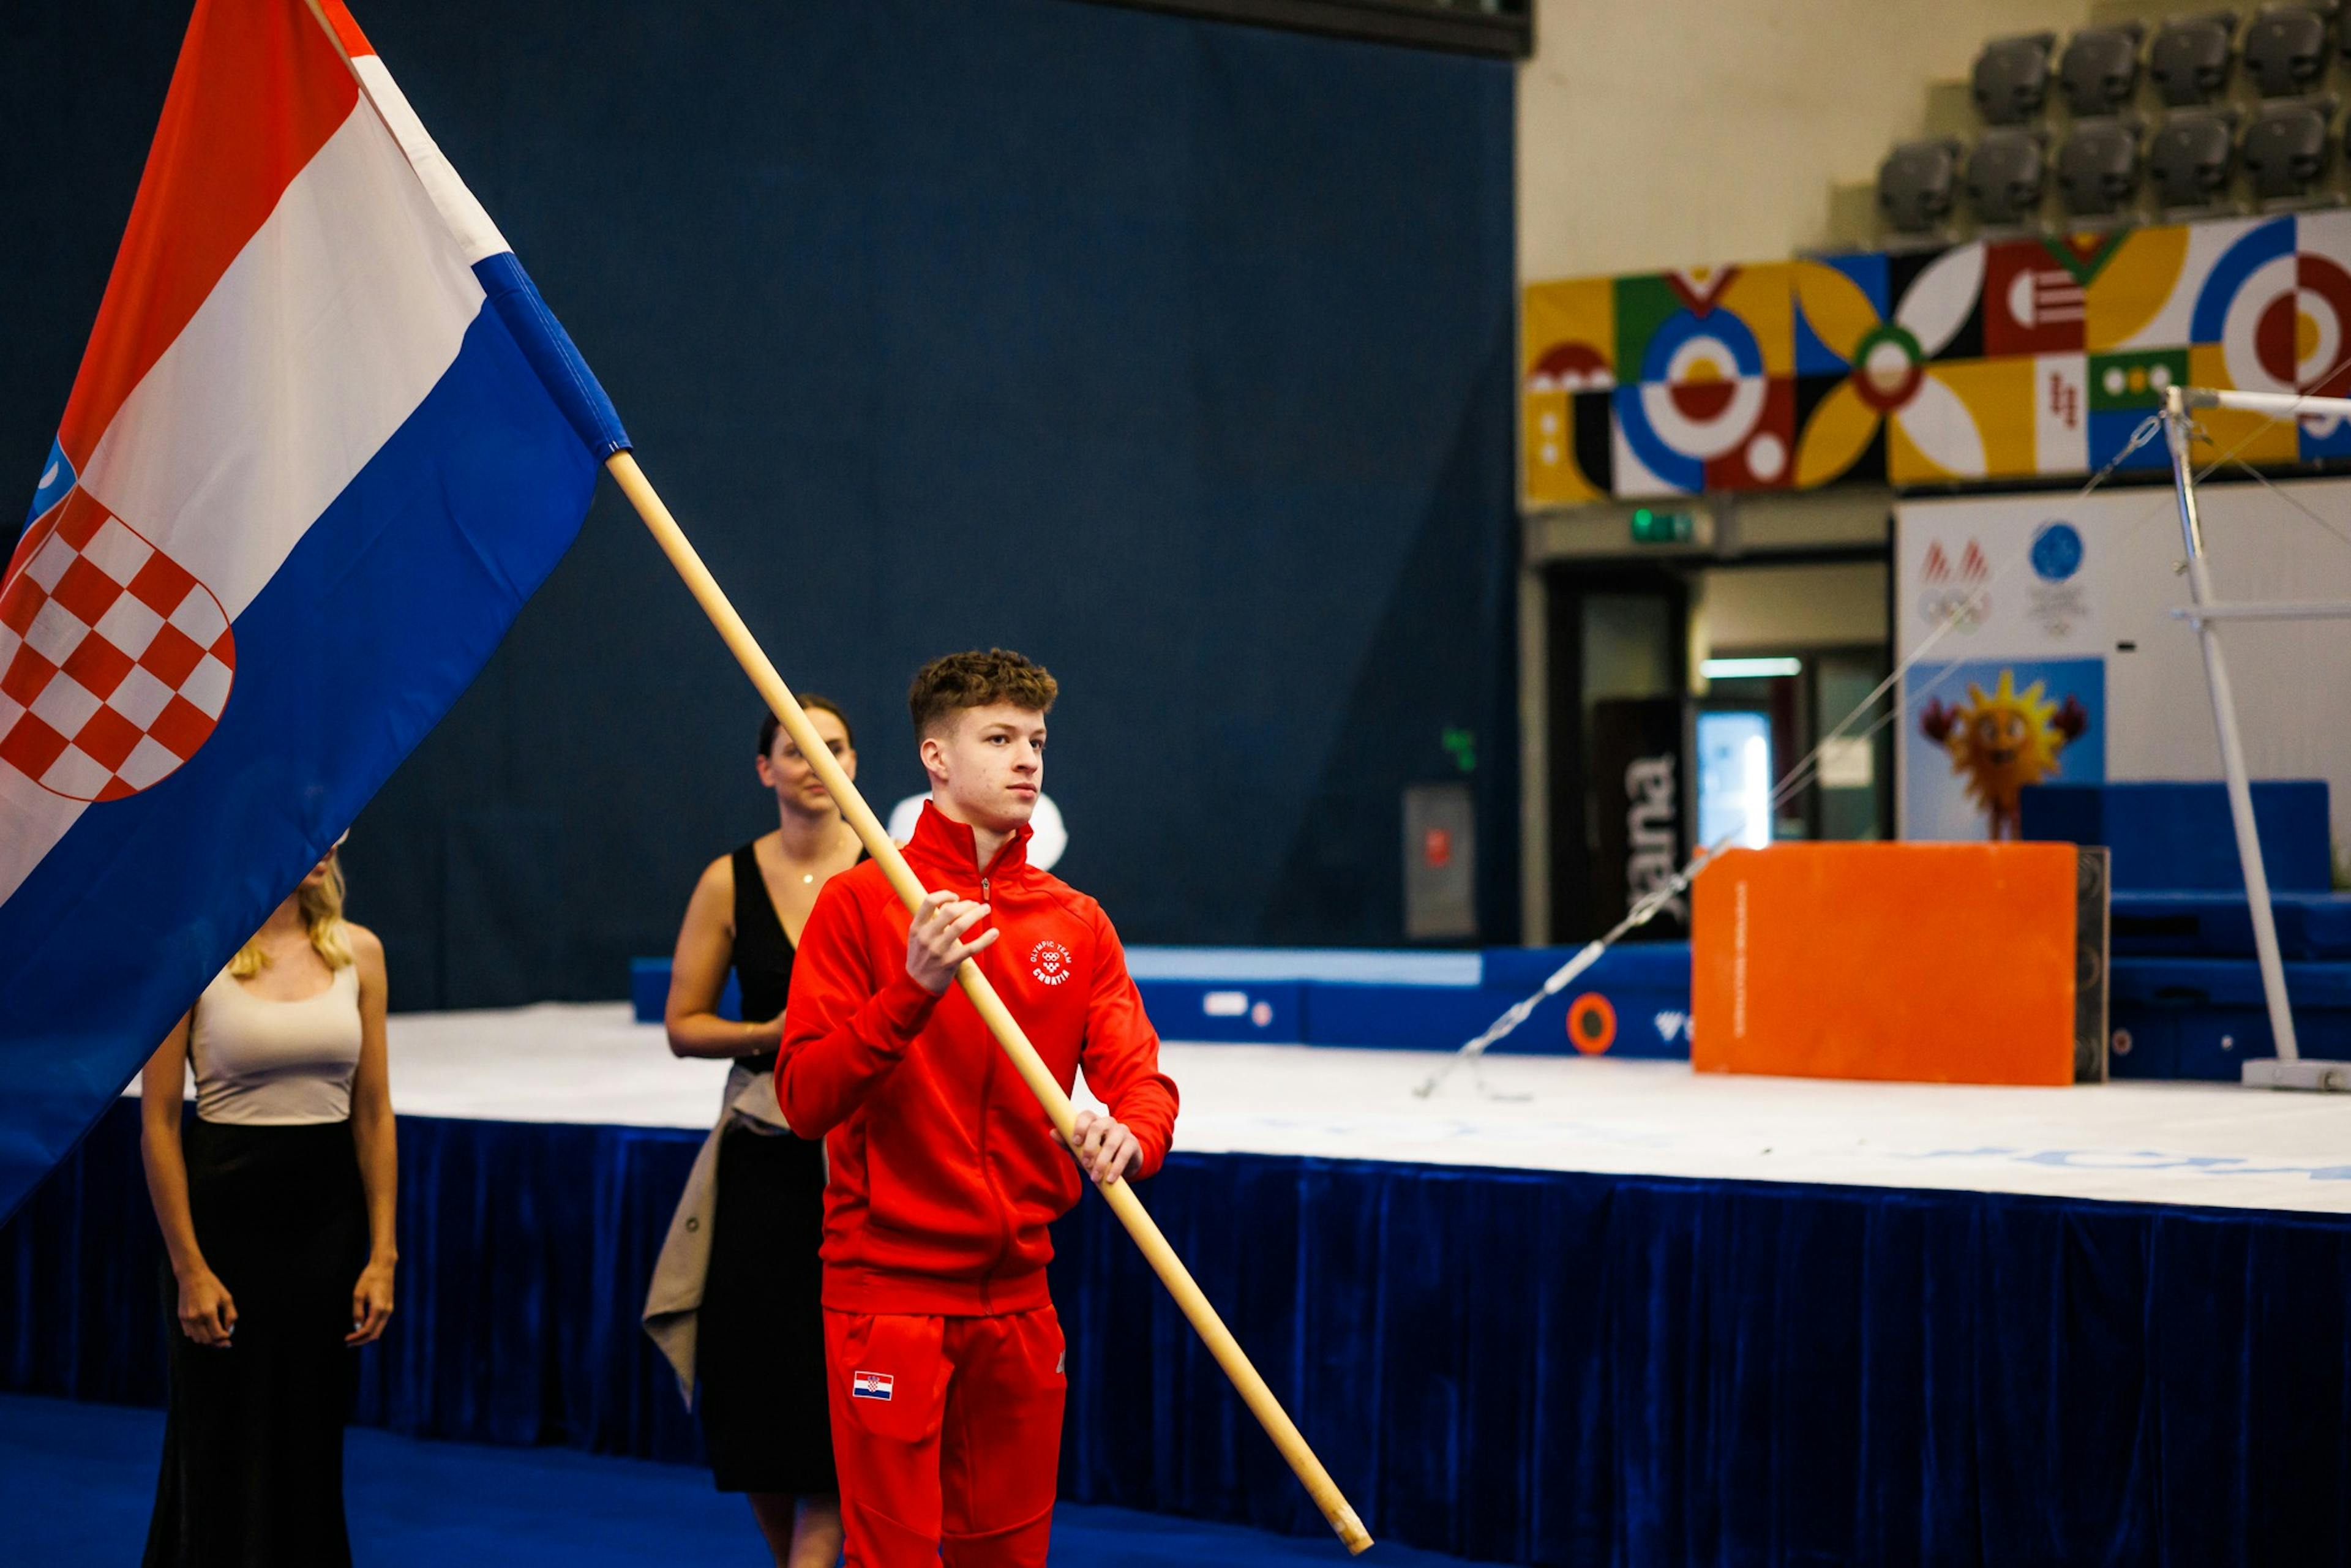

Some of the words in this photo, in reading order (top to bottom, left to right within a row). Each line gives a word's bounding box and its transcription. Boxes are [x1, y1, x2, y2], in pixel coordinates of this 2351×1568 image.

[1030, 940, 1054, 962] OLYMPIC
[1057, 944, 1071, 963] TEAM
[1033, 968, 1070, 985] CROATIA
